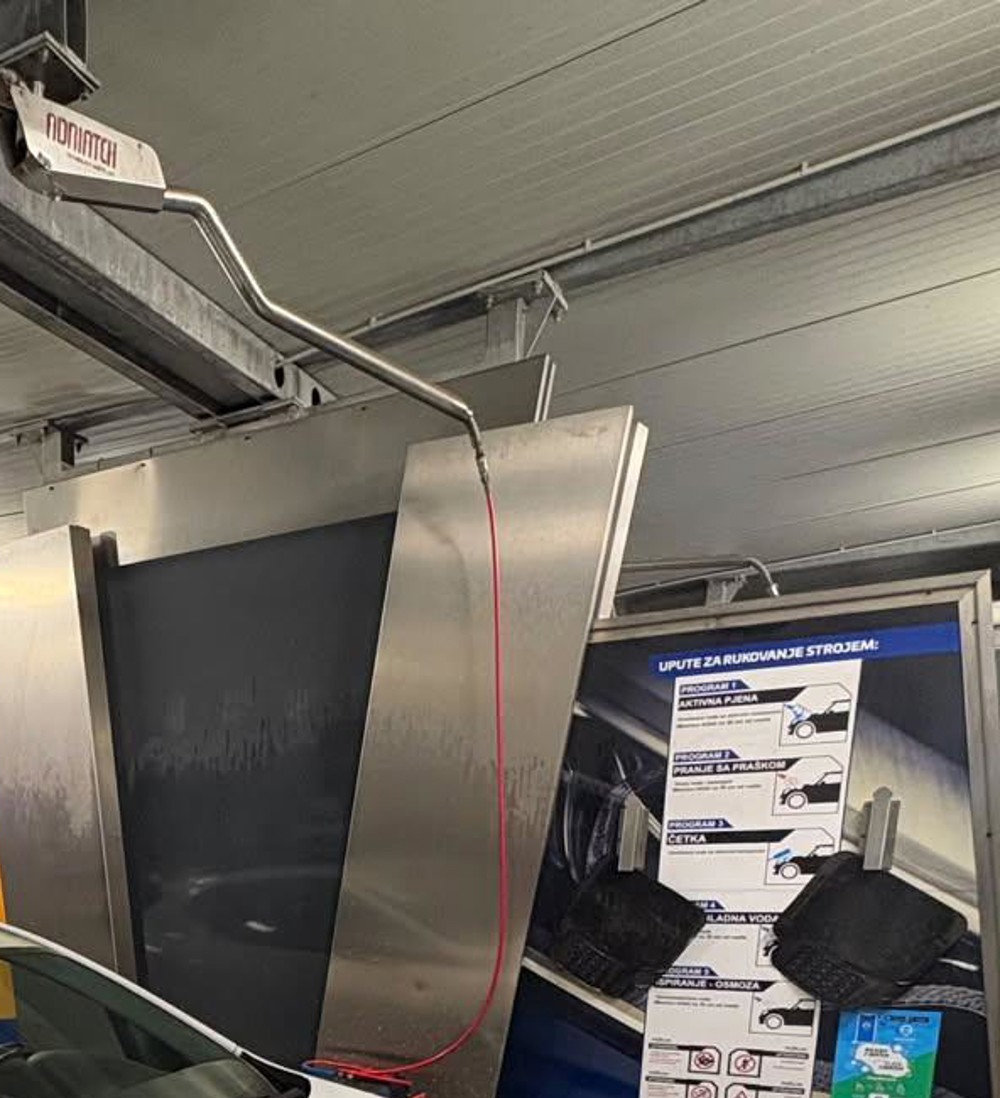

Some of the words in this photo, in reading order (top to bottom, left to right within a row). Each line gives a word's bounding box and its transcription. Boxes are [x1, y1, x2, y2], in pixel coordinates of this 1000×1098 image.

[658, 657, 702, 672] UPUTE
[703, 656, 721, 667] ZA
[723, 646, 804, 665] RUKOVANJE
[806, 639, 880, 657] STROJEM:
[680, 682, 730, 694] PROGRAM
[678, 696, 722, 708] AKTIVNA
[724, 694, 759, 705] PJENA
[674, 752, 722, 762] PROGRAM
[724, 751, 730, 760] 2
[673, 765, 714, 776] PRANJE
[716, 763, 731, 773] SA
[732, 760, 787, 772] PRAŠKOM
[668, 820, 717, 829] PROGRAM
[667, 832, 707, 844] ČETKA
[668, 967, 704, 976] OGRAM
[715, 981, 760, 991] OSMOZA
